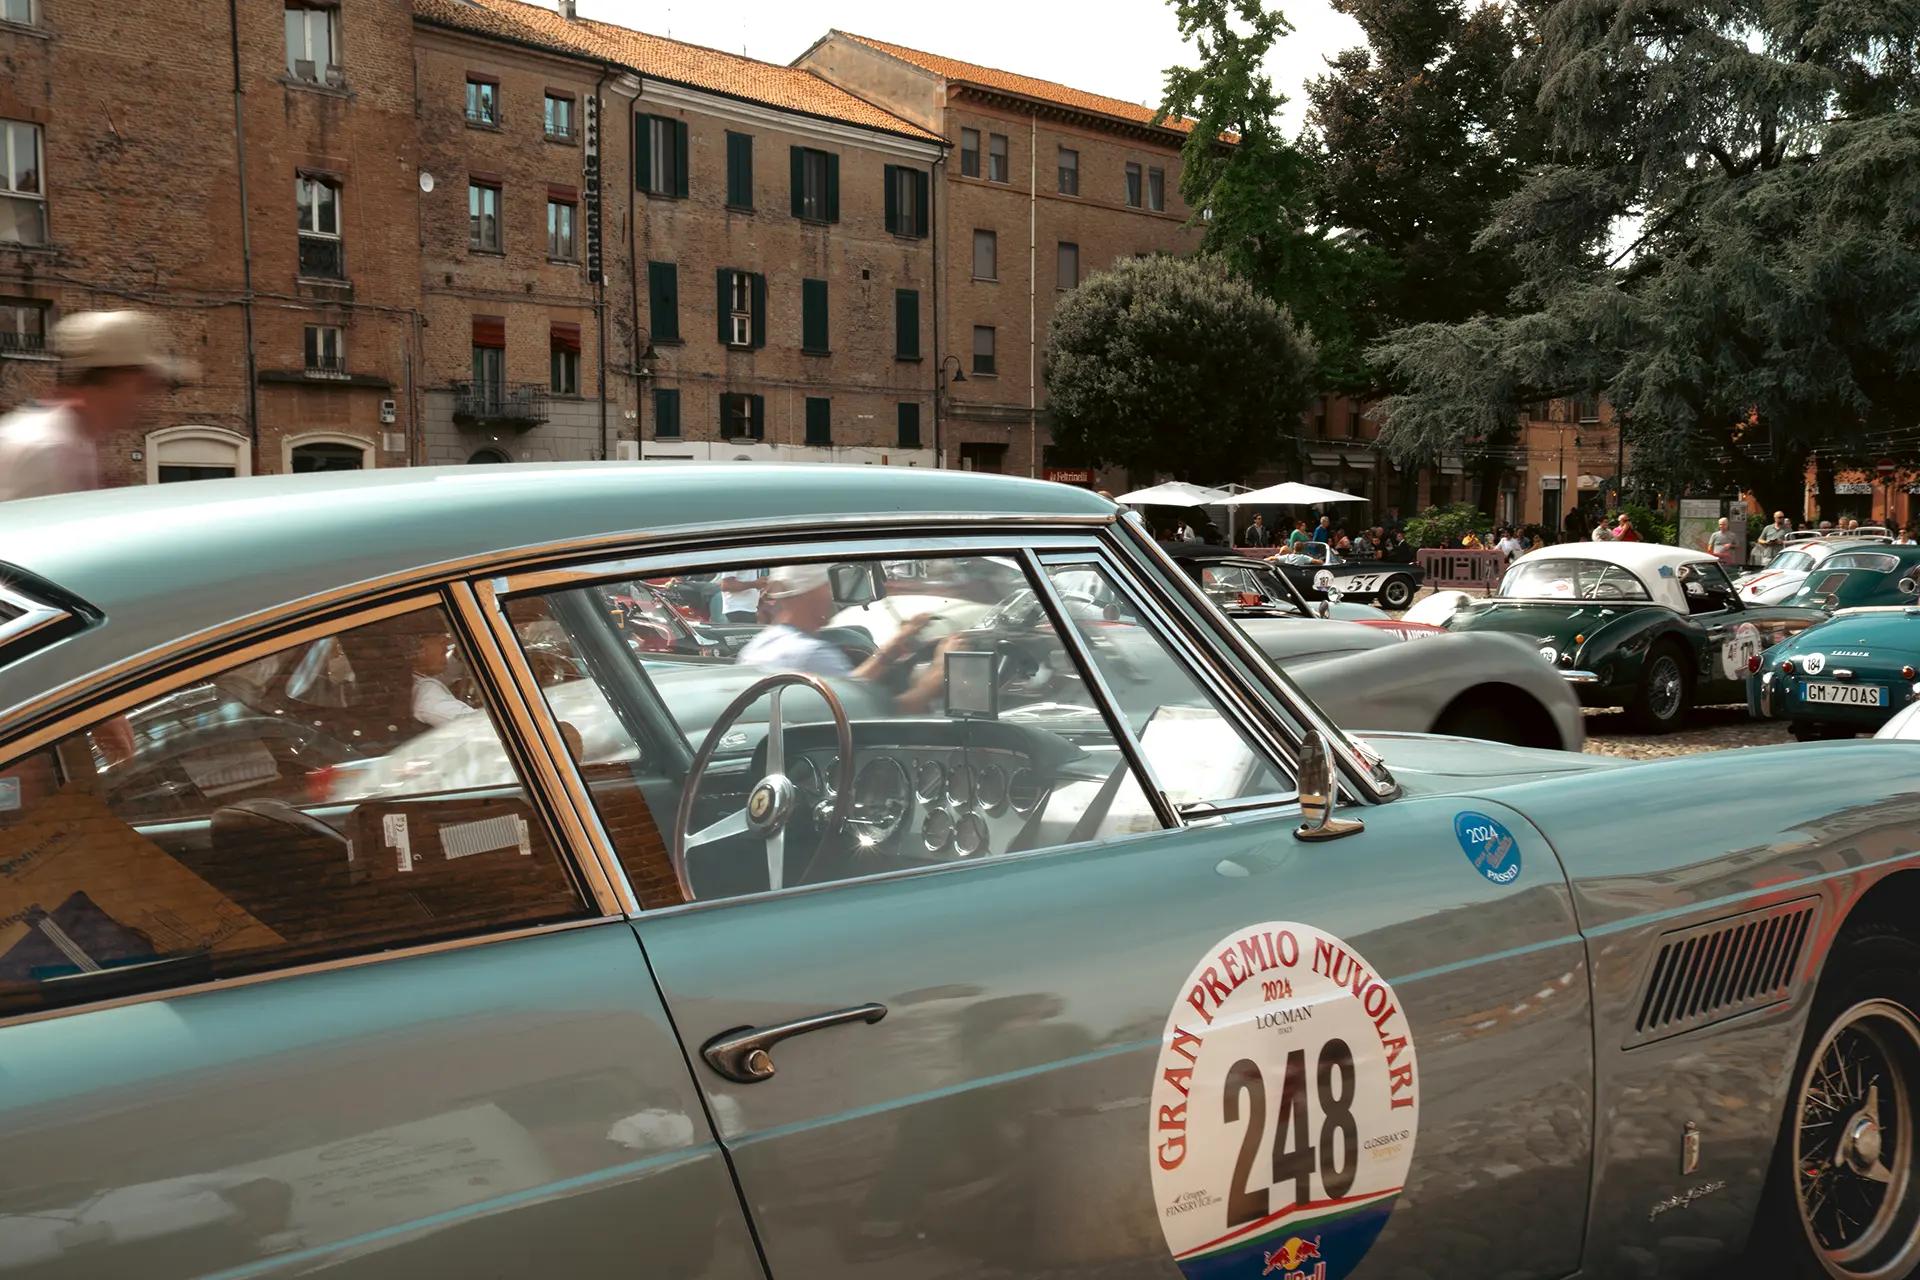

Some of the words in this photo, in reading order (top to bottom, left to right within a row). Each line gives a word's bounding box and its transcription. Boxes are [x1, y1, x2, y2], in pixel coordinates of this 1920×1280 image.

[1347, 574, 1381, 592] 57
[1807, 658, 1821, 672] 184
[1808, 684, 1827, 701] GM
[1831, 686, 1879, 704] 770AS
[1465, 825, 1499, 844] 2024
[1487, 864, 1519, 882] PASSED
[1261, 976, 1293, 1003] 2024
[1255, 1006, 1312, 1030] LOCMAN
[1157, 1024, 1204, 1171] GRAN
[1186, 929, 1299, 1026] PREMIO
[1312, 936, 1415, 1111] NUVOLARI
[1223, 1038, 1359, 1229] 248
